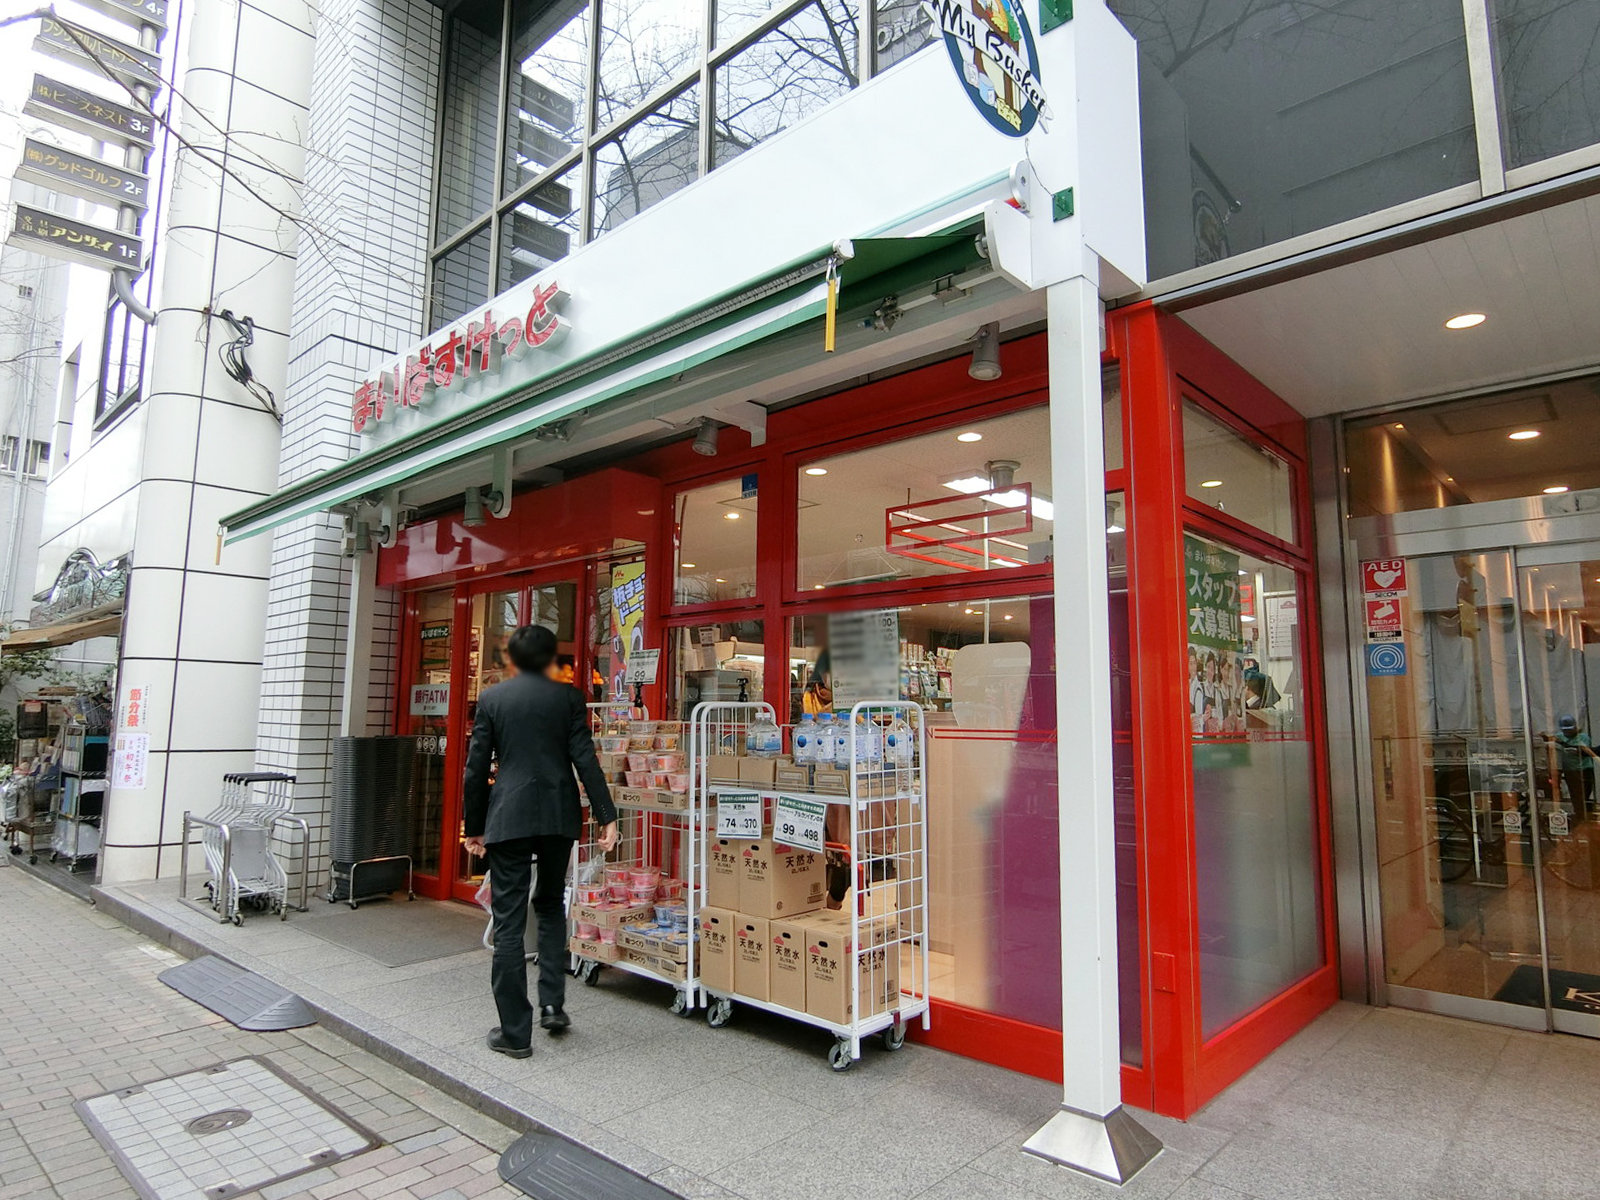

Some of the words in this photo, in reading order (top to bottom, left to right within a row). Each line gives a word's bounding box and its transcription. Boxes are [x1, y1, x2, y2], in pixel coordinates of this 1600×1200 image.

[146, 2, 165, 16] 4F
[130, 118, 150, 134] 3F
[125, 181, 144, 196] 2F
[118, 244, 137, 259] 1F
[352, 280, 559, 434] まいばすけっと
[1367, 560, 1402, 571] AED
[1189, 567, 1237, 608] スタッフ
[634, 670, 646, 681] 99
[414, 689, 448, 704] 銀行ATM
[127, 688, 141, 727] 節分祭
[725, 818, 736, 828] 74
[744, 818, 757, 829] 370
[782, 823, 795, 836] 99
[804, 828, 819, 842] 498
[713, 852, 736, 864] 天然水
[744, 857, 768, 870] 天然水
[785, 852, 815, 868] 天然水
[704, 930, 727, 943] 天然水
[740, 937, 763, 952] 天然水
[775, 944, 800, 960] 天然水
[811, 954, 838, 970] 天然水
